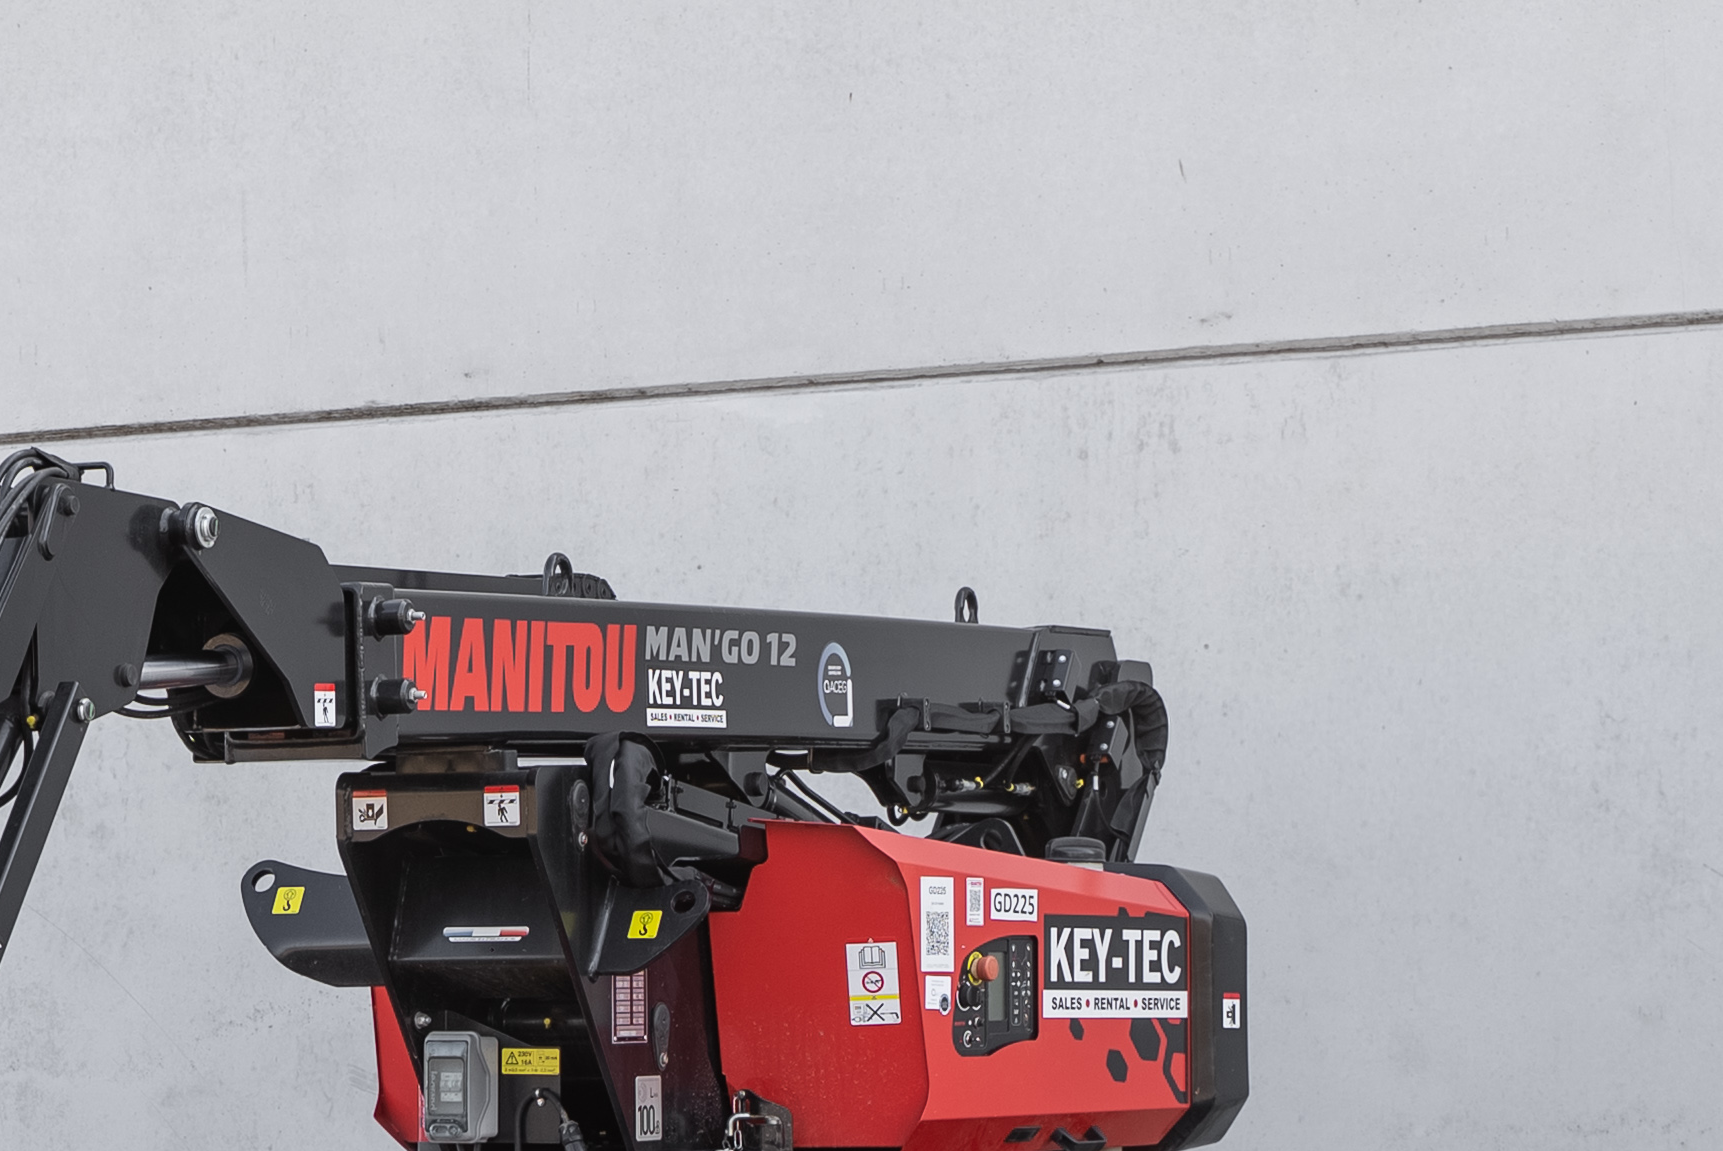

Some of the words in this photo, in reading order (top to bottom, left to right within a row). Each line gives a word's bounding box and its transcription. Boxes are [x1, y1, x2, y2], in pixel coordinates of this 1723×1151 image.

[645, 625, 761, 665] MAN'GO
[766, 632, 797, 667] 12
[402, 615, 637, 713] MANITOU
[648, 668, 724, 707] KEY-TEC
[650, 712, 668, 722] SALES
[674, 713, 695, 723] RENTAL
[701, 714, 724, 724] SERVICE
[993, 892, 1035, 915] GD225
[1050, 926, 1182, 984] KEY-TEC
[1051, 996, 1082, 1010] SALES
[1094, 997, 1130, 1011] RENTAL
[1141, 997, 1181, 1011] SERVICE
[638, 1105, 656, 1136] 100
